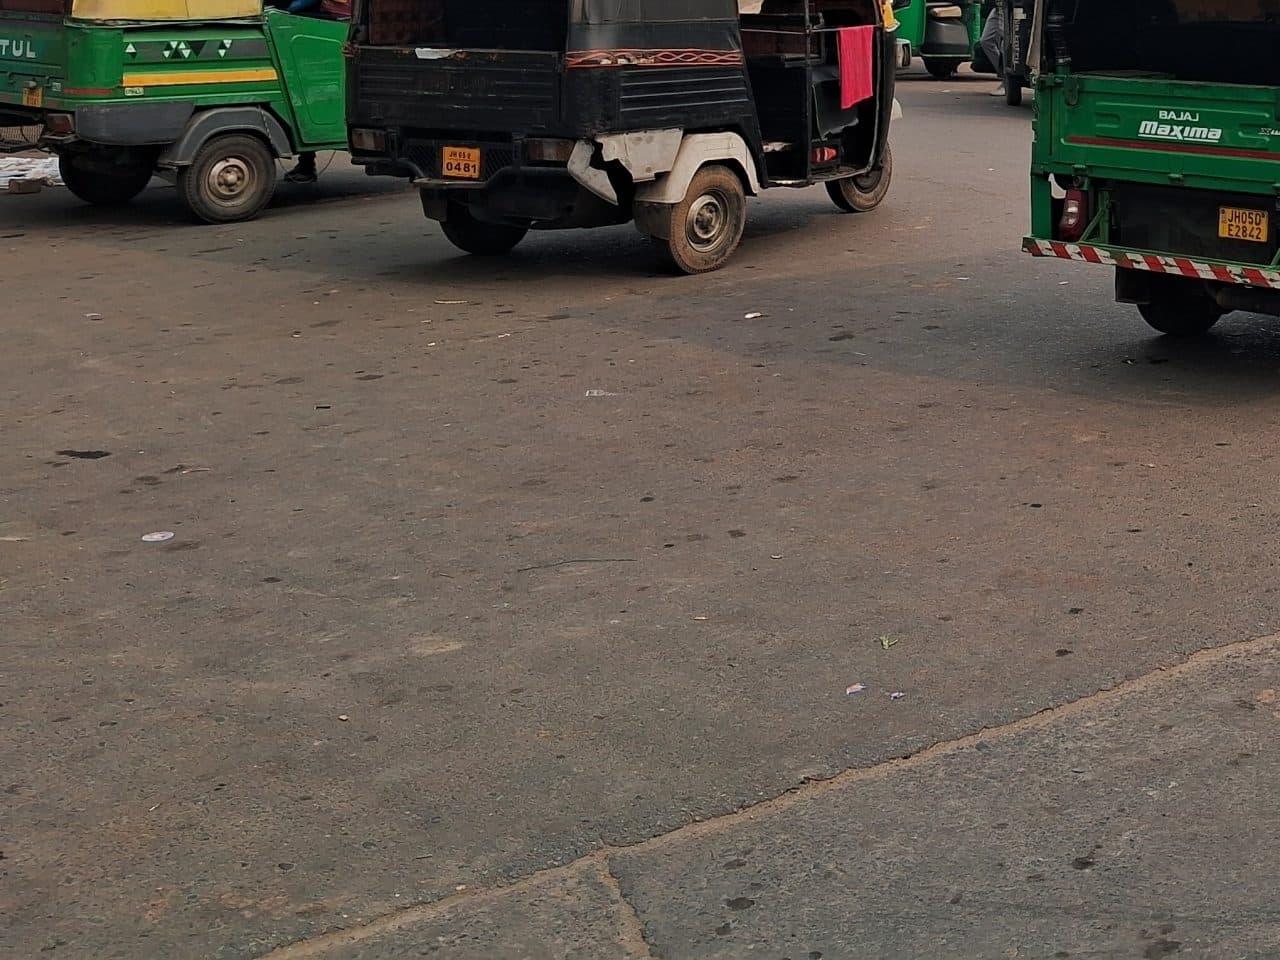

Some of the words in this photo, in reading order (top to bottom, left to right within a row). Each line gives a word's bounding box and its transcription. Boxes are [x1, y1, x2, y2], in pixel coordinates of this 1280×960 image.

[1158, 110, 1200, 122] BAJAJ
[446, 162, 477, 174] 0481
[1228, 224, 1262, 240] E2842
